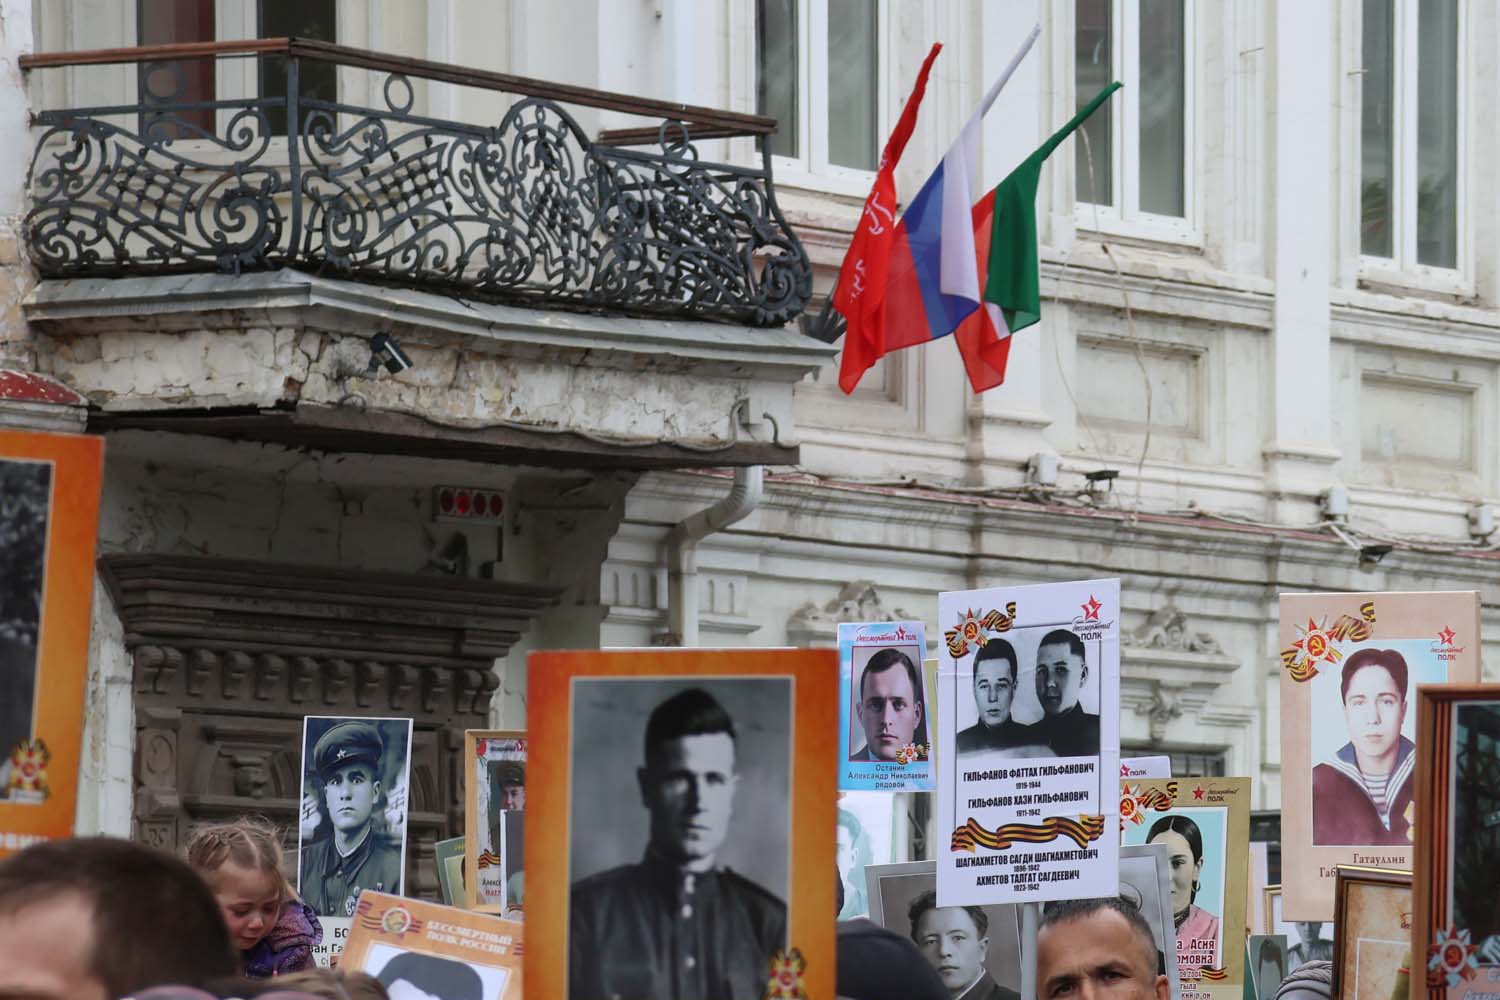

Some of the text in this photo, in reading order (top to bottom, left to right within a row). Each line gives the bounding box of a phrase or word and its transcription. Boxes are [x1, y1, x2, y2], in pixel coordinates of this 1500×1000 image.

[848, 772, 928, 781] Александр Николаевич
[963, 763, 1094, 782] ГИЛЬФАНОВ ФАТТАХ ГИЛЬФАНОВИЧ
[968, 790, 1089, 809] ГИЛЬФАНОВ ХАЗИ ГИЛЬФАНОВИЧ
[956, 849, 1098, 868] ШАГИАХМЕТОВ САГДИ ШАГИАХМЕТОВИЧ
[1353, 853, 1405, 866] Гатауллин
[976, 870, 1080, 886] АХМЕТОВ ТАЛГАТ САГДЕЕВИЧ
[1190, 939, 1214, 949] Асия
